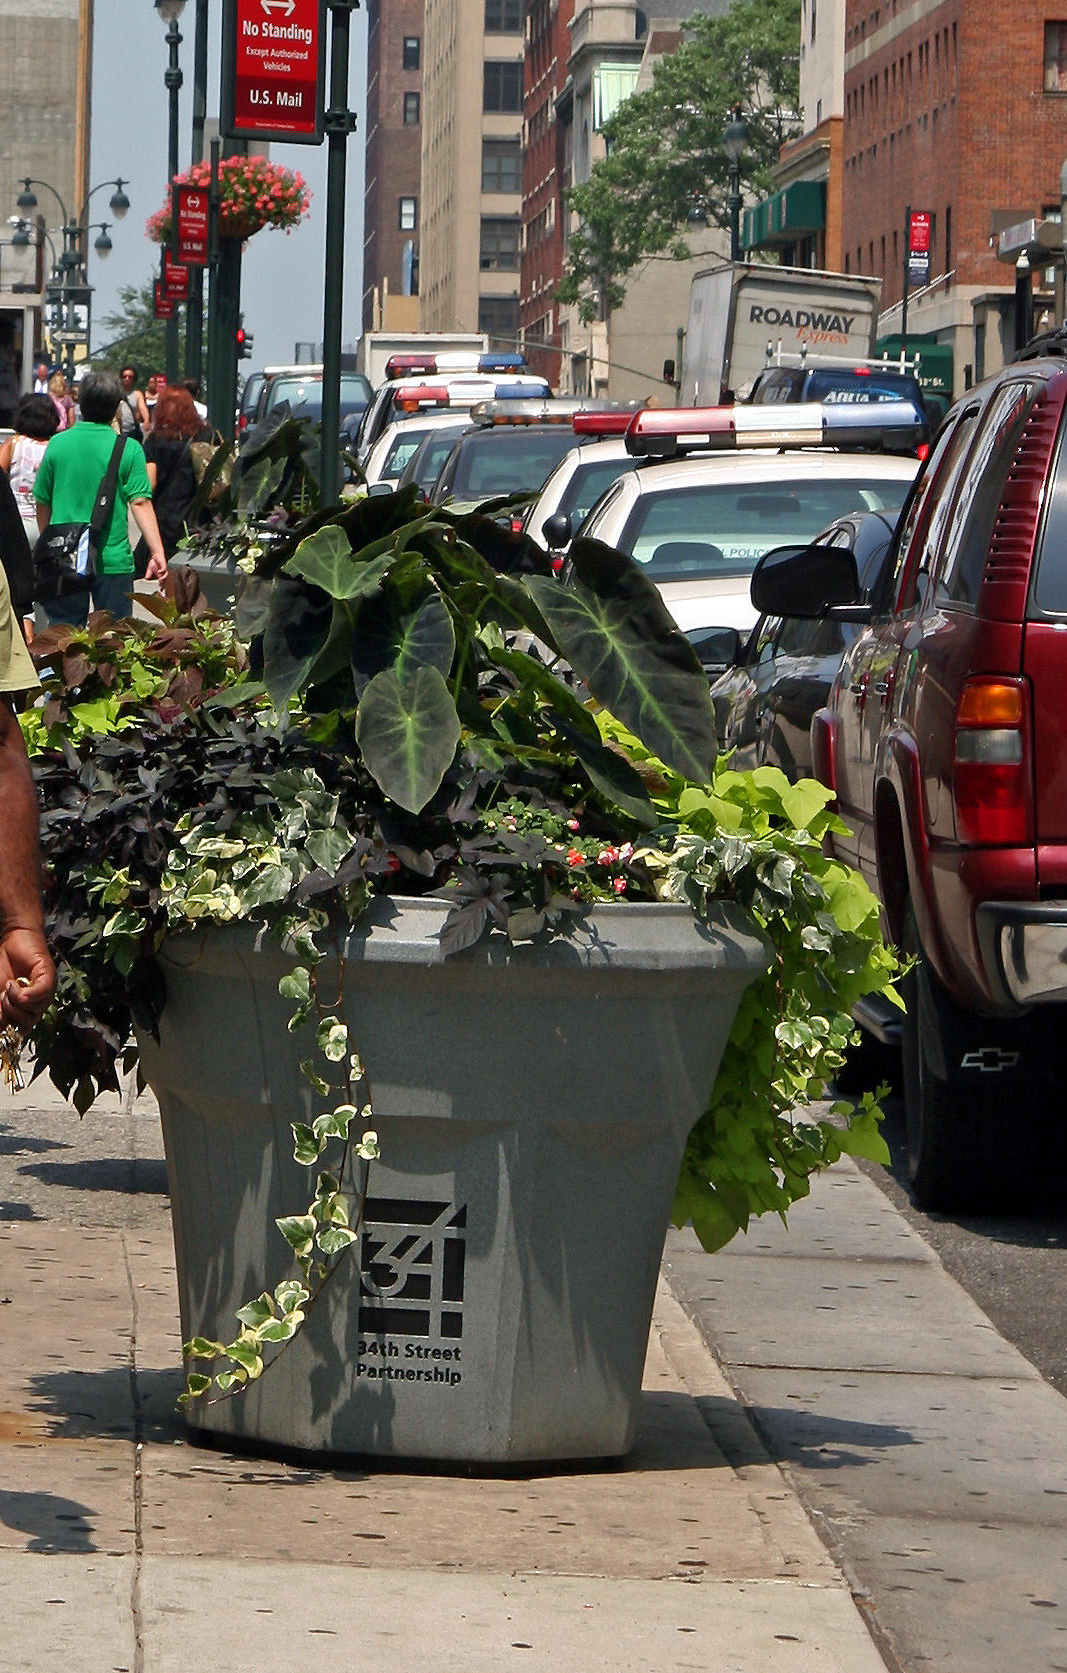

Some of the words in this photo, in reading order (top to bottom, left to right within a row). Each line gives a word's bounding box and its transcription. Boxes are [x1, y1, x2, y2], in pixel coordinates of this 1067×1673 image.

[242, 20, 259, 36] No
[261, 22, 313, 45] Standing
[246, 46, 269, 60] Except
[270, 48, 309, 60] Authorized
[263, 61, 291, 72] Vehicles
[249, 89, 273, 105] U.S.
[276, 91, 302, 107] Mail
[749, 305, 855, 334] ROADWAY
[796, 326, 848, 345] Express
[357, 1340, 399, 1358] 34th
[404, 1343, 462, 1362] Street
[355, 1362, 463, 1387] Partnership
